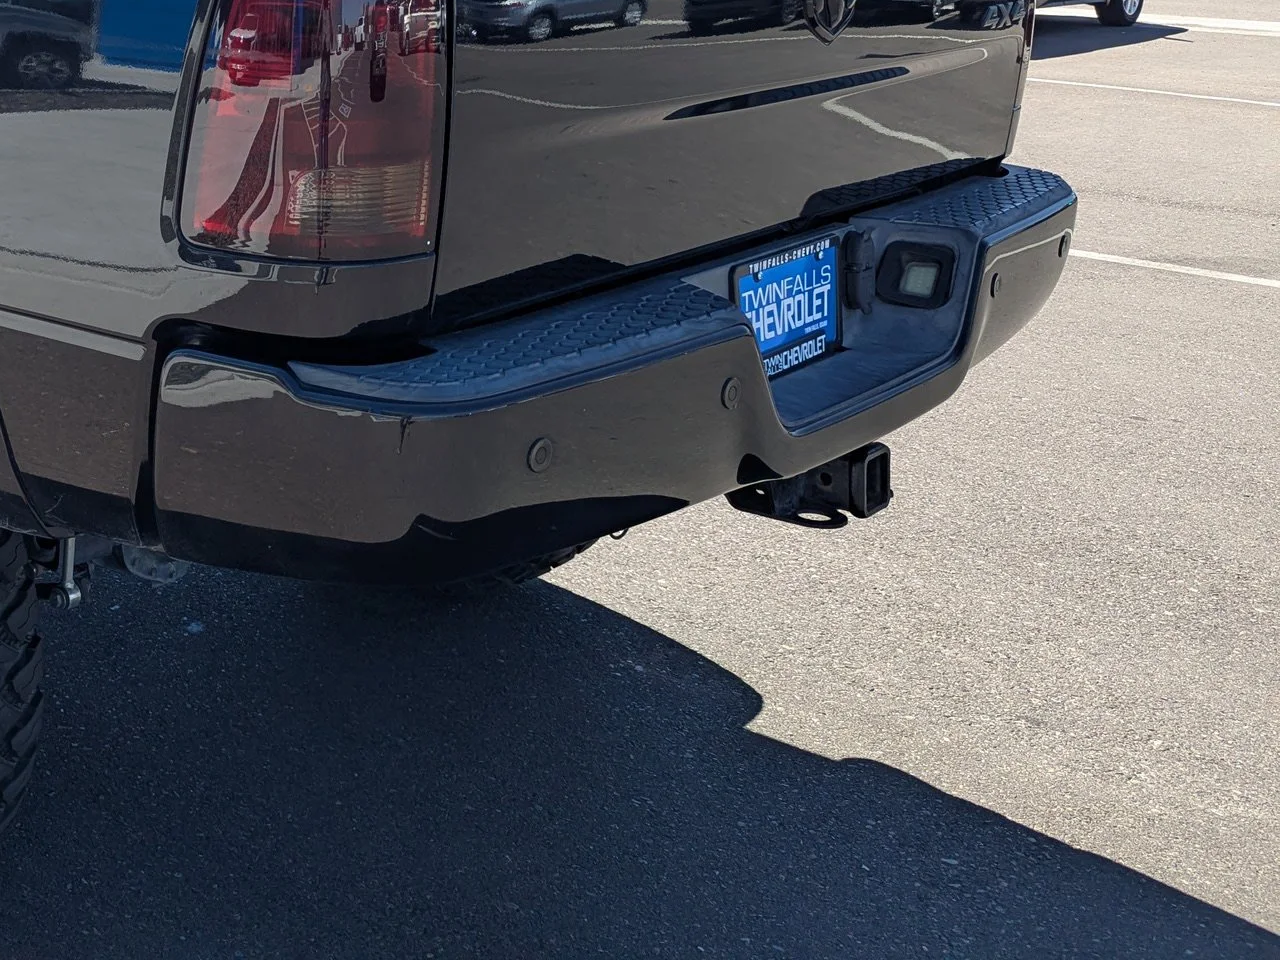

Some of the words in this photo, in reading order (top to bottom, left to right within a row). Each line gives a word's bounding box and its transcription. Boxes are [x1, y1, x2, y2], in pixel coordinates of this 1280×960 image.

[983, 0, 1026, 29] 4X4
[749, 239, 830, 274] TWINFALLS-CHEVY.COM
[745, 284, 831, 342] HEVROLET
[763, 353, 783, 371] TWIN
[782, 334, 826, 370] CHEVROLET
[766, 361, 783, 377] ALLS
